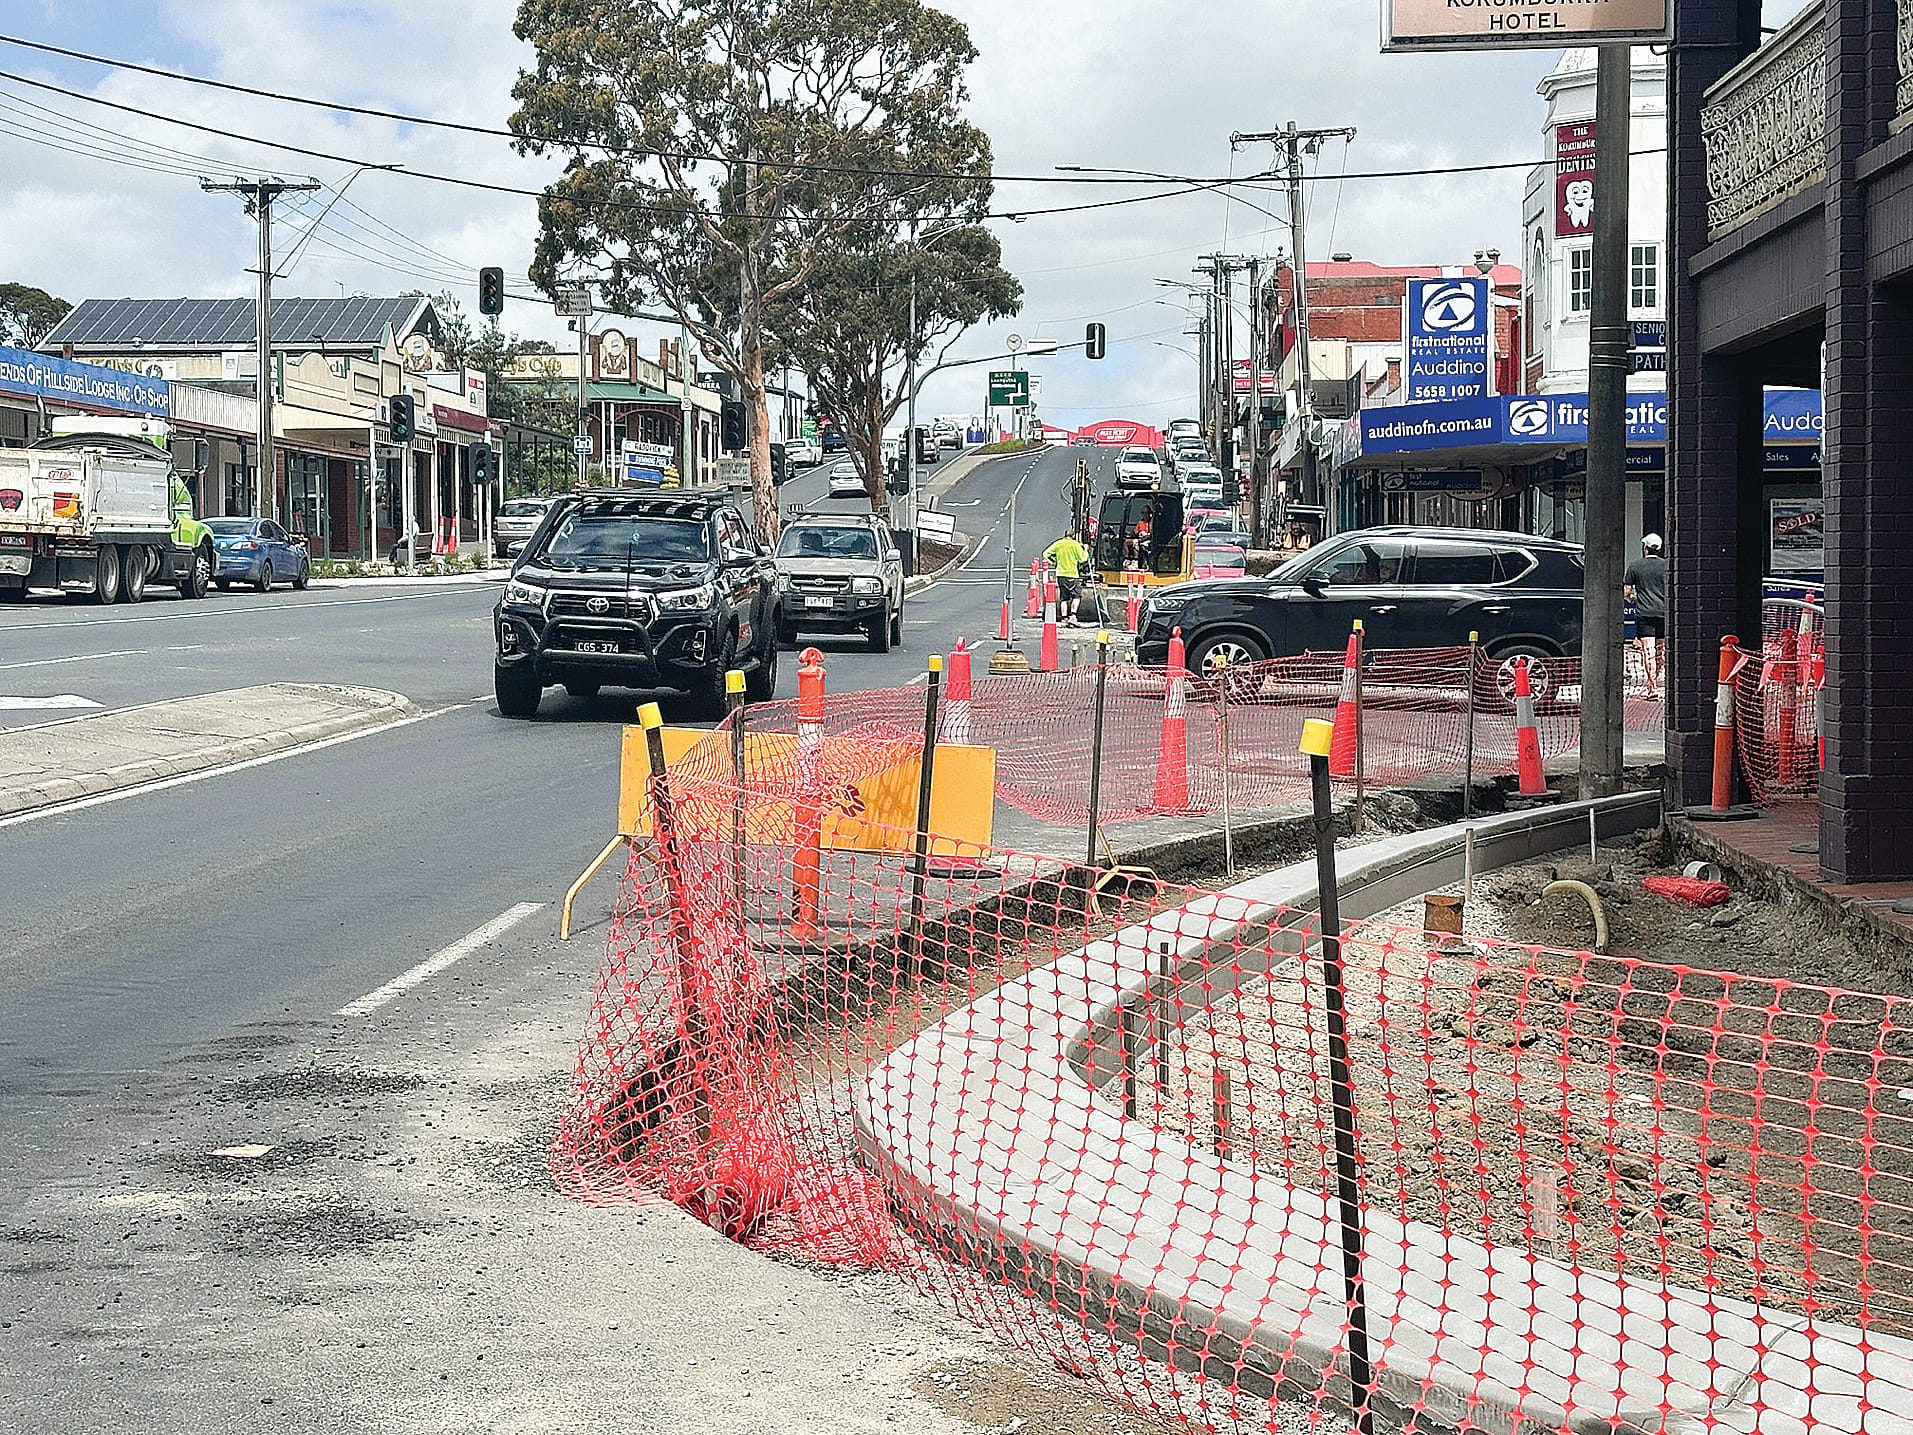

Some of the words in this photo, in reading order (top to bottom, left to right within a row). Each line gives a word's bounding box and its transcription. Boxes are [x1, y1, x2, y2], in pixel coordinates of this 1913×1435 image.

[1490, 13, 1566, 30] HOTEL
[1572, 127, 1589, 136] THE
[1558, 139, 1596, 152] KORUMBUR
[1557, 153, 1596, 174] DENTIS
[1635, 322, 1666, 334] SENIO
[1411, 348, 1438, 356] REAL
[1446, 347, 1485, 355] ESTATE
[1412, 359, 1485, 376] Auddino
[0, 363, 26, 384] ENDS
[43, 366, 85, 395] HILLSIDE
[84, 373, 115, 400] LODGE
[148, 389, 169, 410] SHOP
[1415, 385, 1446, 398] 5658
[1451, 384, 1481, 397] 1007
[1368, 417, 1492, 439] auddinofn.com.au
[1765, 452, 1789, 461] Sales
[1778, 513, 1816, 532] SOLD
